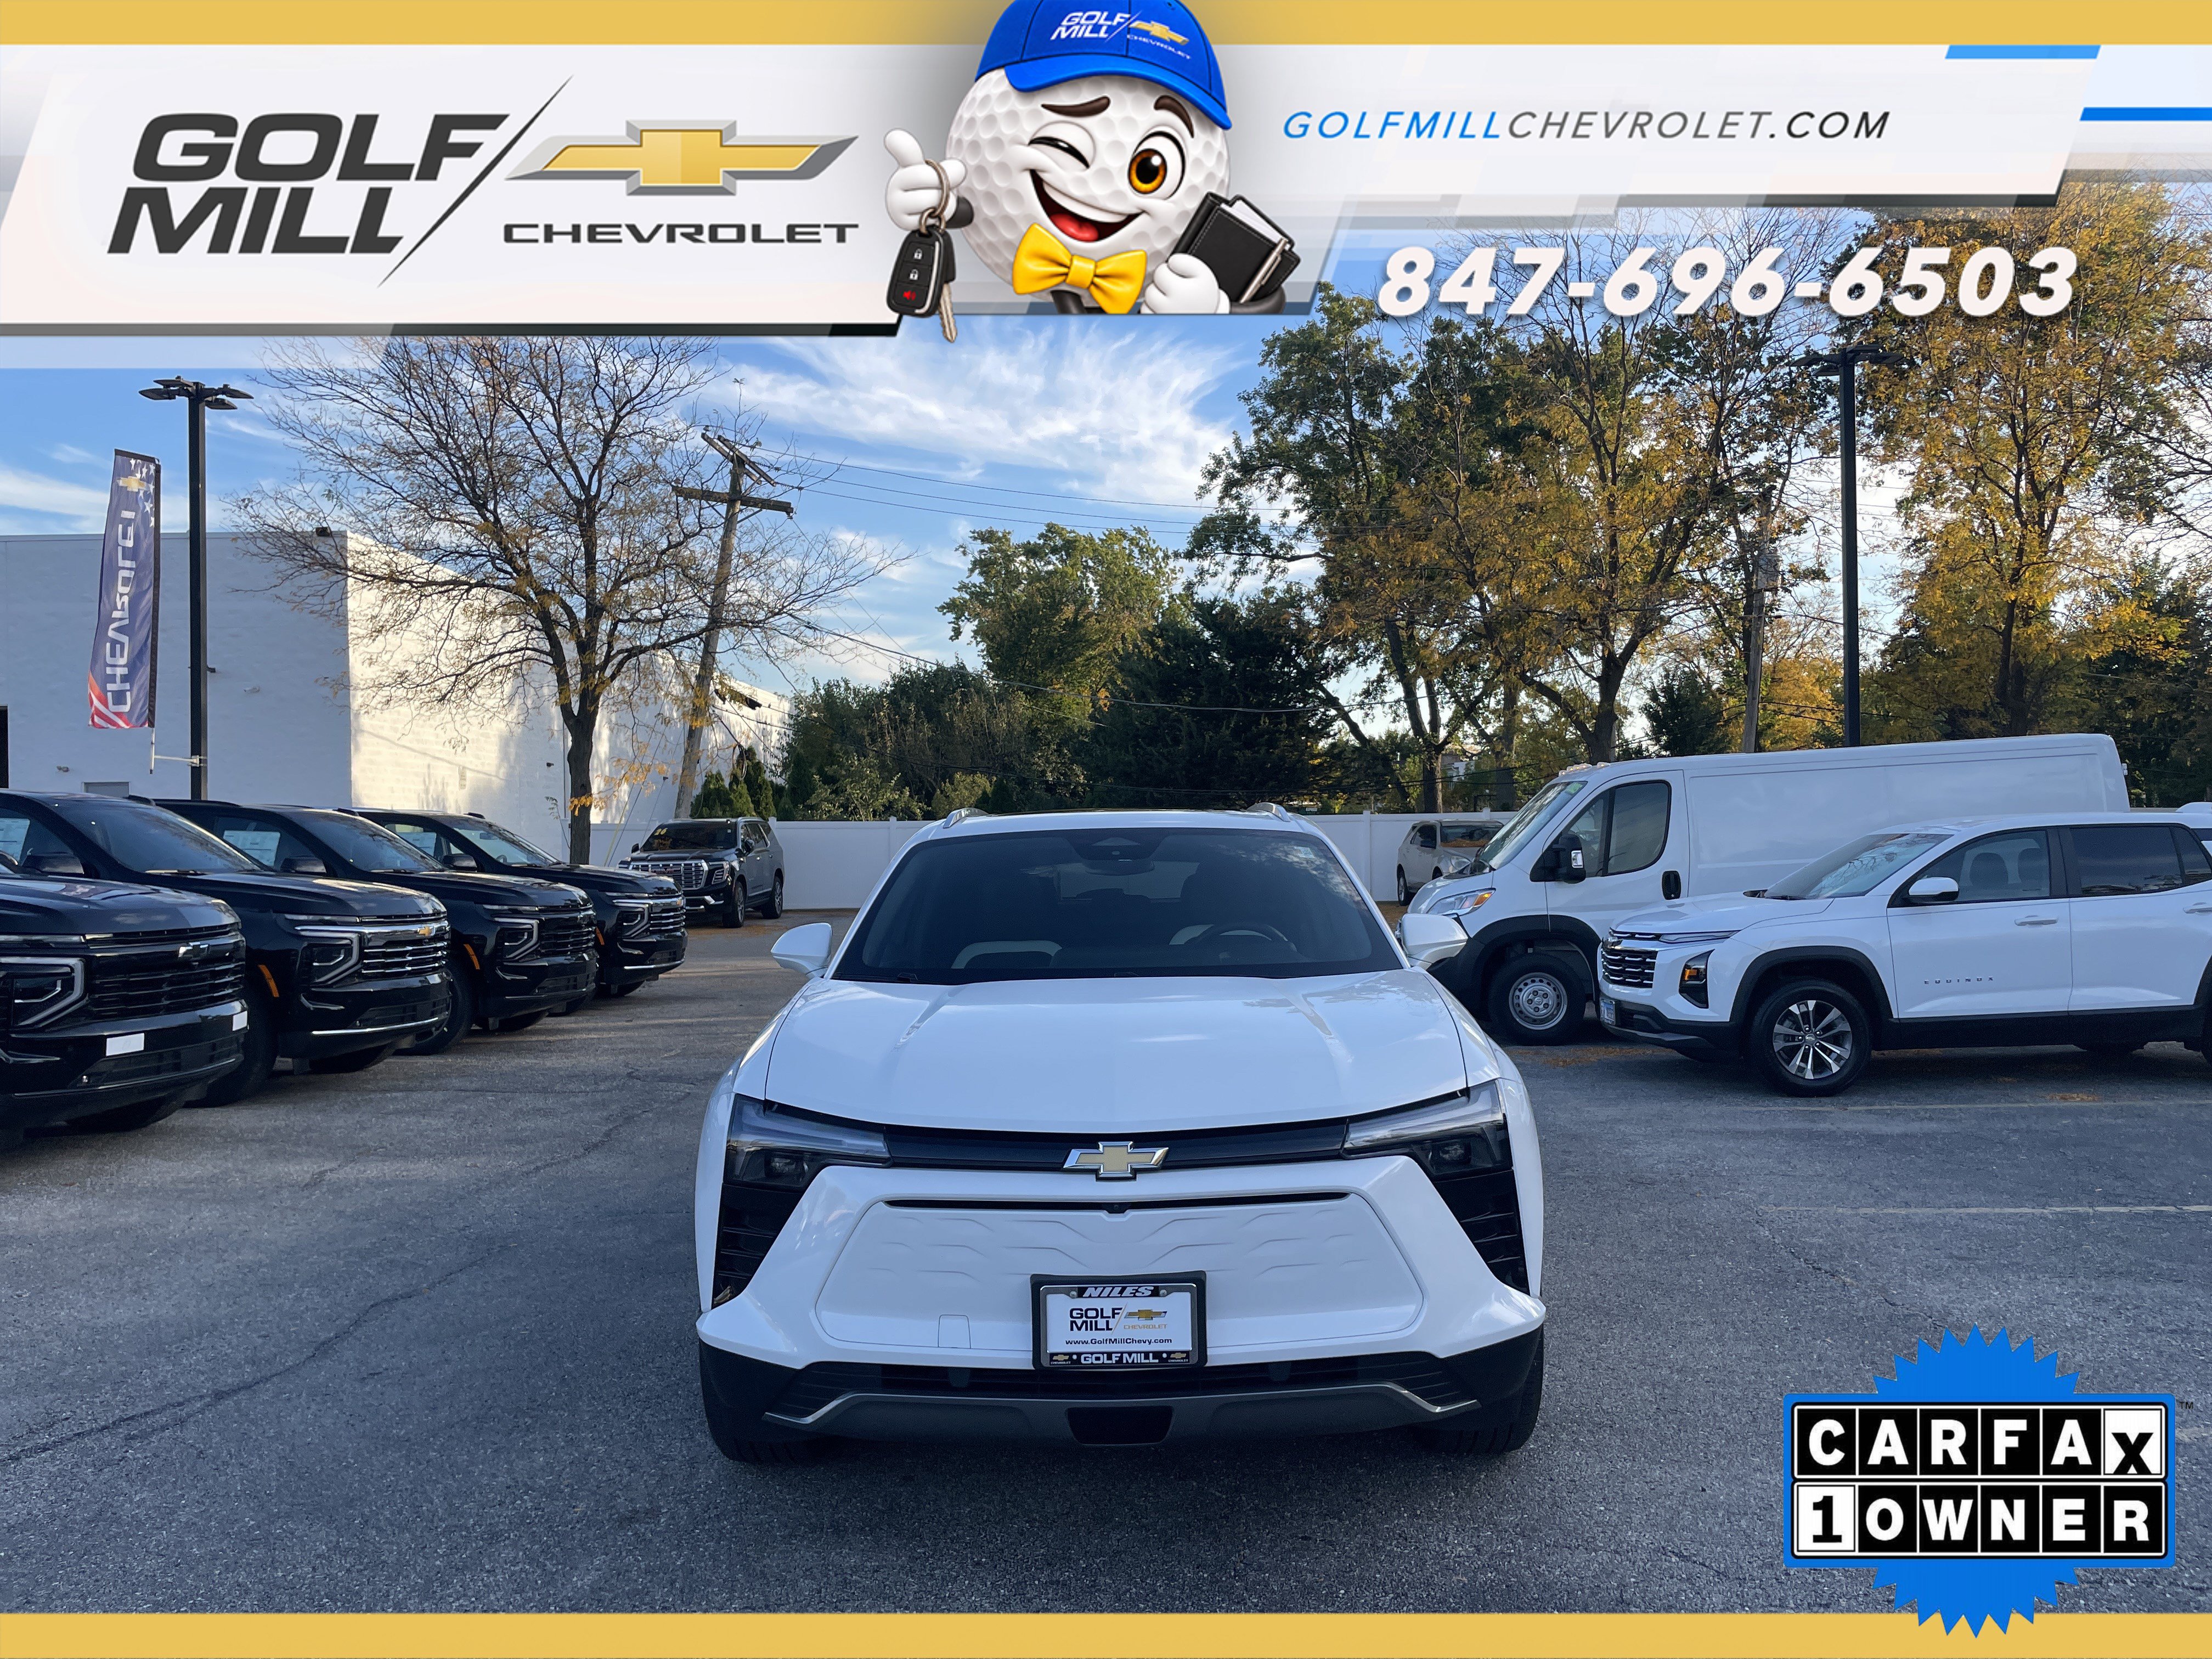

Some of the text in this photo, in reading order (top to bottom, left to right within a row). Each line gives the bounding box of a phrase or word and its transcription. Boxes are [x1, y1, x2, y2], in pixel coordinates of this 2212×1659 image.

[1924, 976, 1993, 984] EQUINOX
[1082, 1286, 1154, 1297] NILES
[1069, 1307, 1123, 1319] GOLF
[1070, 1319, 1113, 1331] MILL
[1081, 1353, 1159, 1364] GOLF MILL
